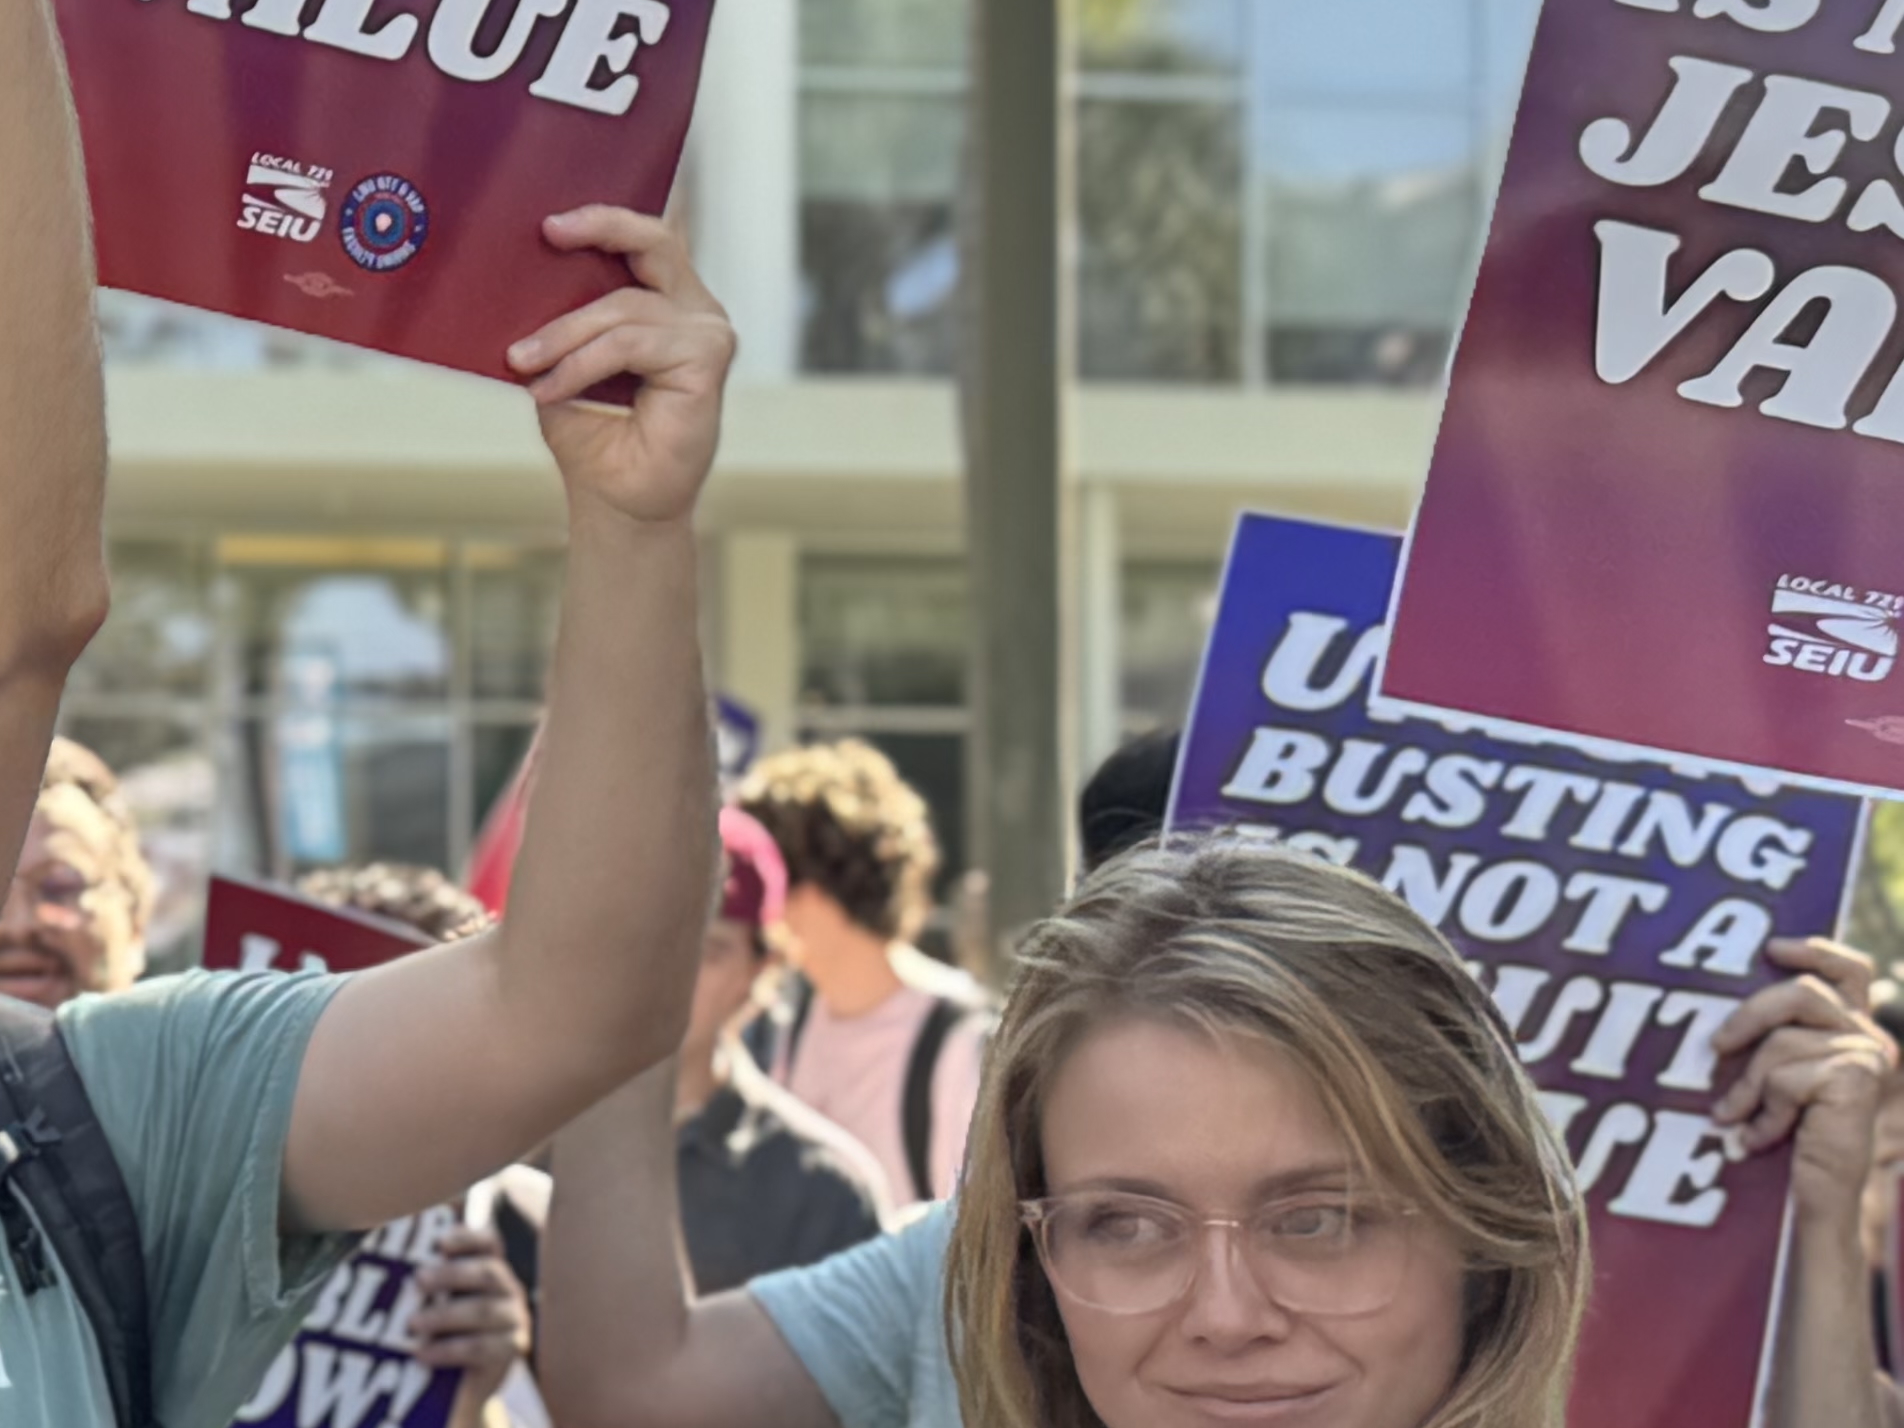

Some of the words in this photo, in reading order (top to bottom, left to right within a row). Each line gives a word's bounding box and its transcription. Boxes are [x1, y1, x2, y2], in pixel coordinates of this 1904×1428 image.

[251, 151, 302, 172] LOCAL
[236, 206, 321, 243] SEIU
[1777, 573, 1856, 601] LOCAL
[1763, 638, 1895, 682] SEIU
[1221, 726, 1812, 890] BUSTING
[1660, 896, 1774, 977] A
